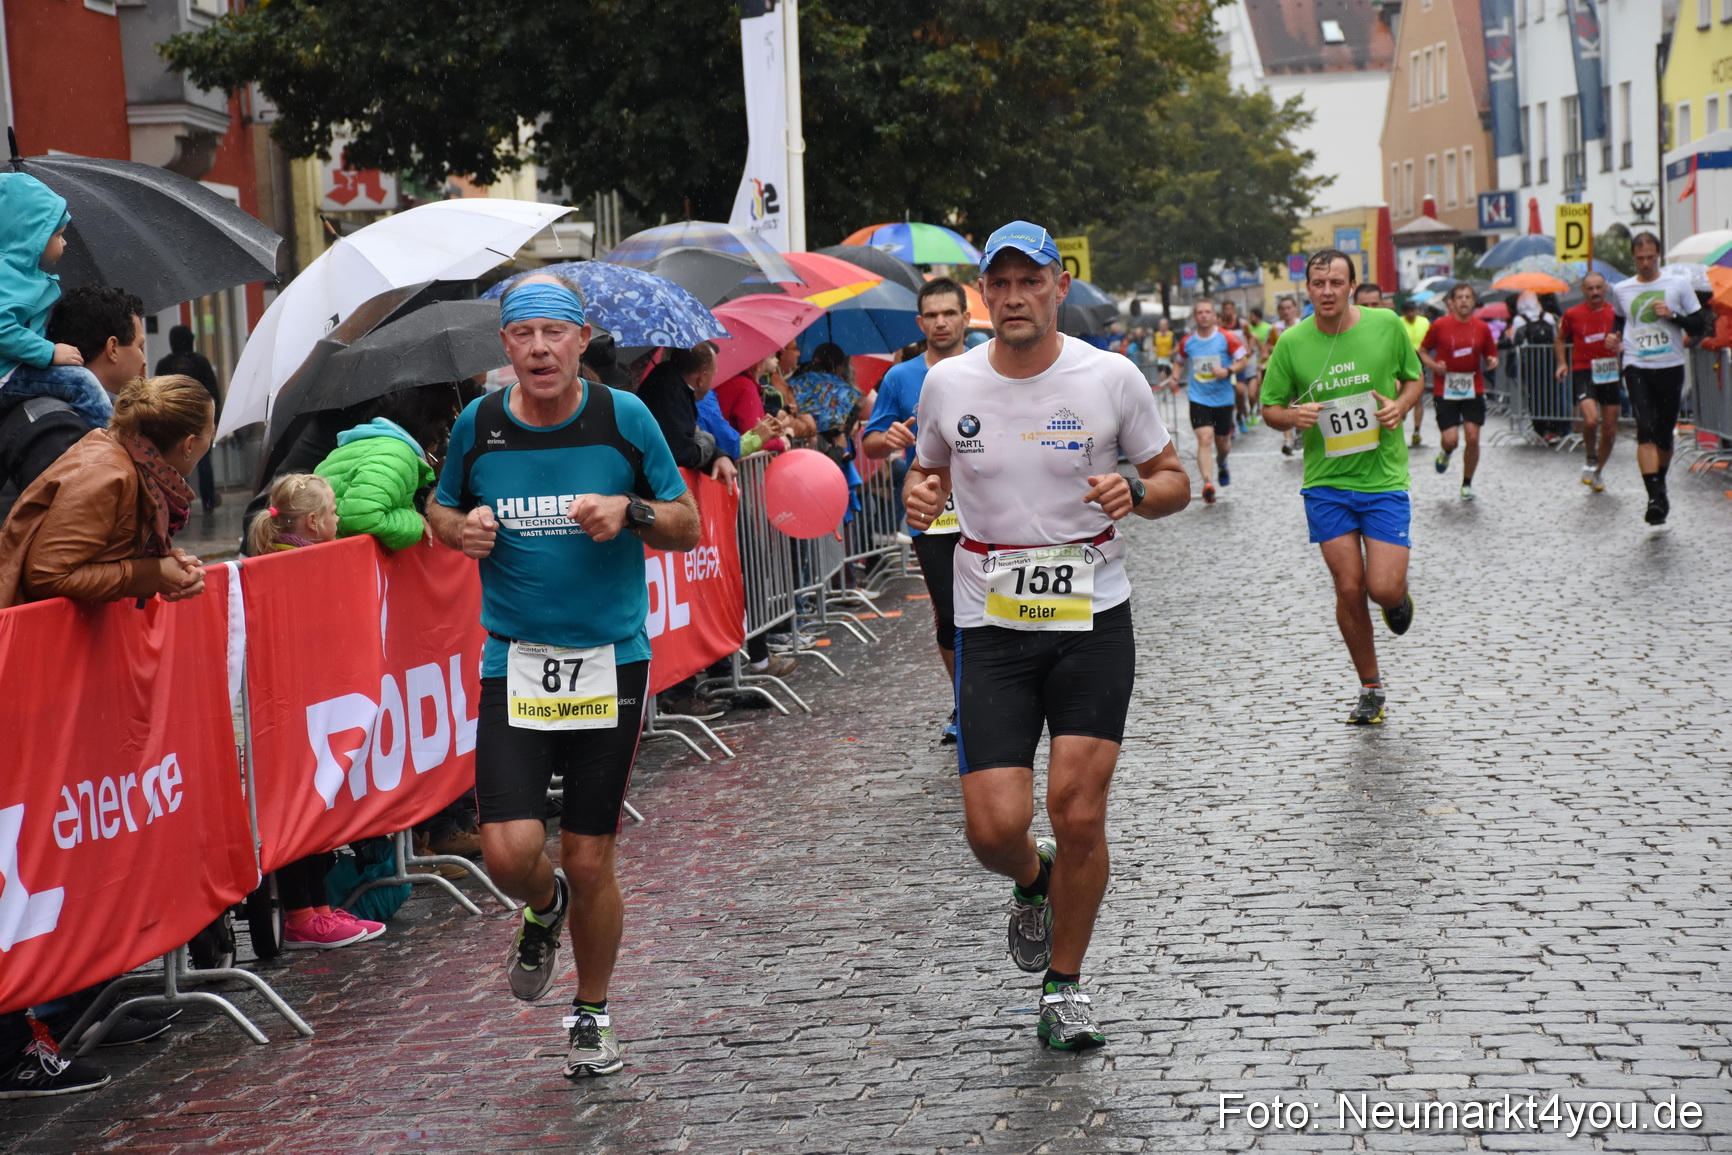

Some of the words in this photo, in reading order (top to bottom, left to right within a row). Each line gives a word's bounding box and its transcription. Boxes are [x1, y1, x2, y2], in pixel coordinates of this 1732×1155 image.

[1560, 206, 1588, 217] Block
[1566, 222, 1584, 249] D
[1328, 361, 1355, 376] JONI
[1325, 373, 1370, 391] LÄUFER
[1330, 408, 1369, 434] 613
[955, 440, 984, 448] PARTL
[496, 494, 590, 518] HUBE
[520, 529, 543, 537] WASTE
[544, 528, 567, 536] WATER
[998, 557, 1032, 568] NeuerMarkt
[1011, 564, 1074, 595] 758
[1019, 604, 1056, 619] Peter
[542, 658, 583, 694] 87
[518, 702, 609, 718] Hans-Werner
